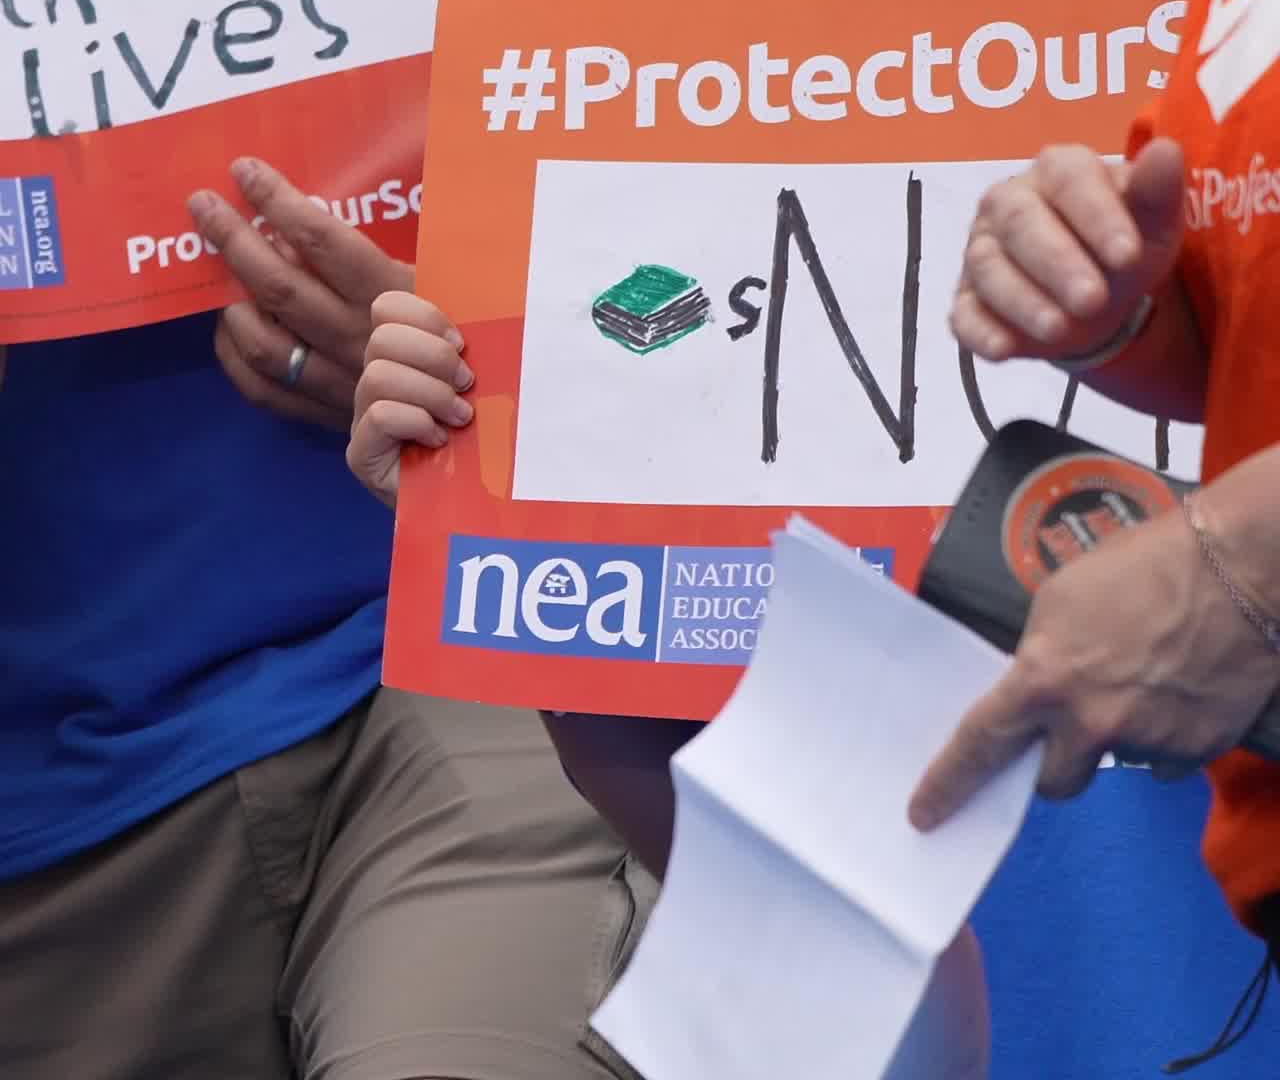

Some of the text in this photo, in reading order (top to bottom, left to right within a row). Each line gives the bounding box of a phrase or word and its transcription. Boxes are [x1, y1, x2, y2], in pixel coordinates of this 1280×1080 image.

[482, 0, 1188, 132] #ProtectOurS
[31, 190, 57, 276] nea.org
[452, 553, 647, 648] nea
[671, 597, 768, 620] EDUCA
[674, 562, 776, 588] NATIO
